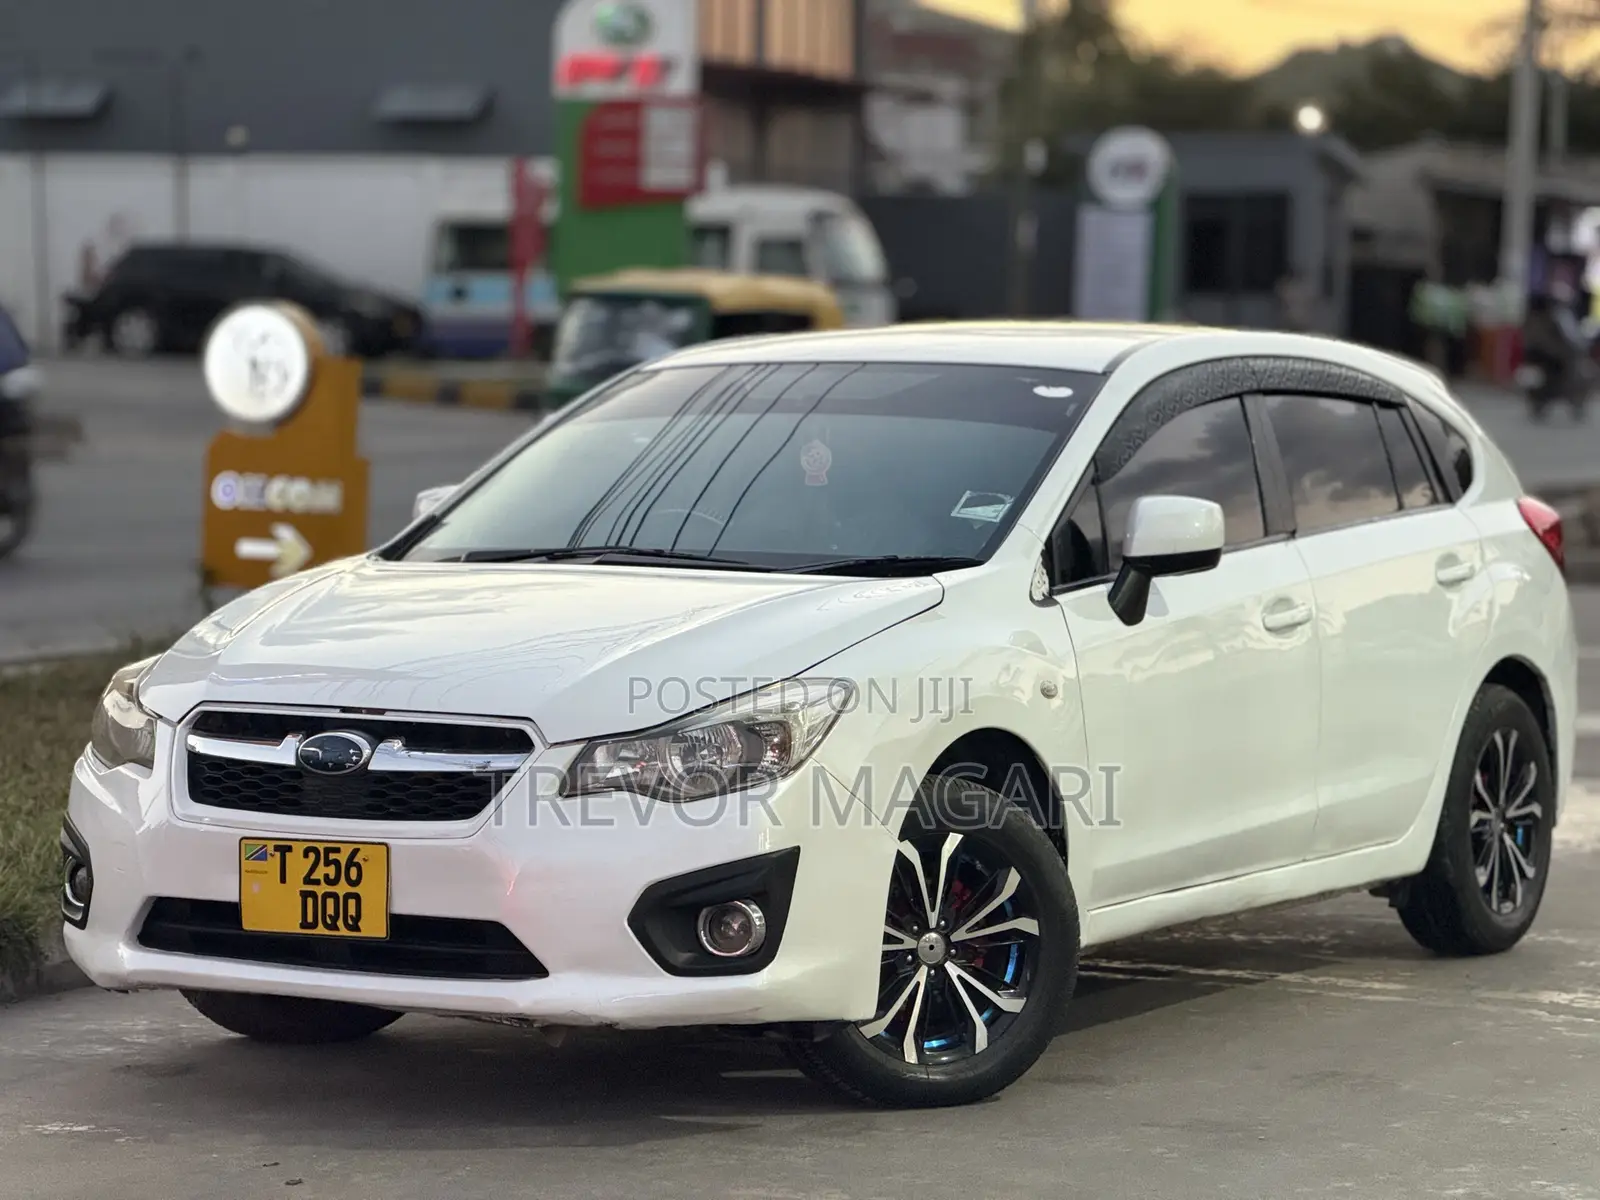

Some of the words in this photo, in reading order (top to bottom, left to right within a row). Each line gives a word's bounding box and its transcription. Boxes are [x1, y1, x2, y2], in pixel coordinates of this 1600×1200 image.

[273, 844, 293, 884] T
[302, 845, 363, 888] 256
[299, 889, 362, 932] DQQ
